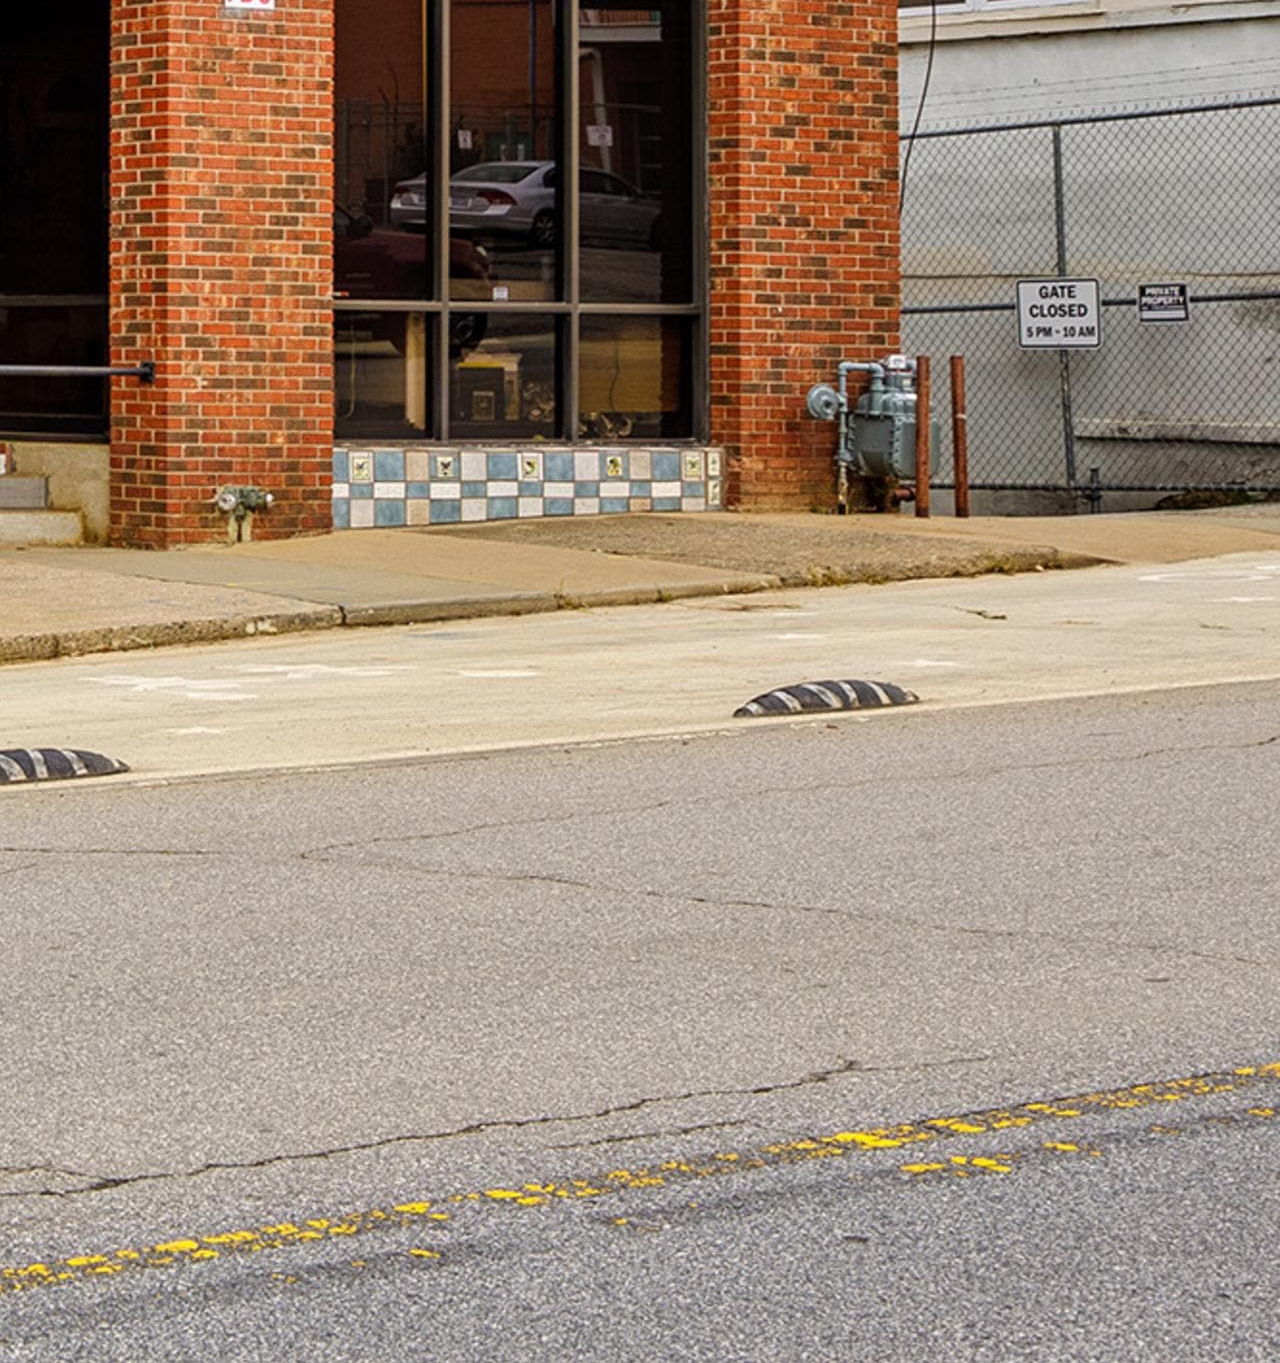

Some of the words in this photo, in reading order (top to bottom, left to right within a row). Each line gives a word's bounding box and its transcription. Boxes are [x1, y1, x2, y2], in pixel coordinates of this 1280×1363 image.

[1039, 285, 1076, 299] GATE
[1028, 303, 1088, 318] CLOSED
[1026, 326, 1034, 338] 5
[1035, 326, 1053, 337] PM
[1063, 326, 1075, 337] 10
[1078, 325, 1096, 337] AM
